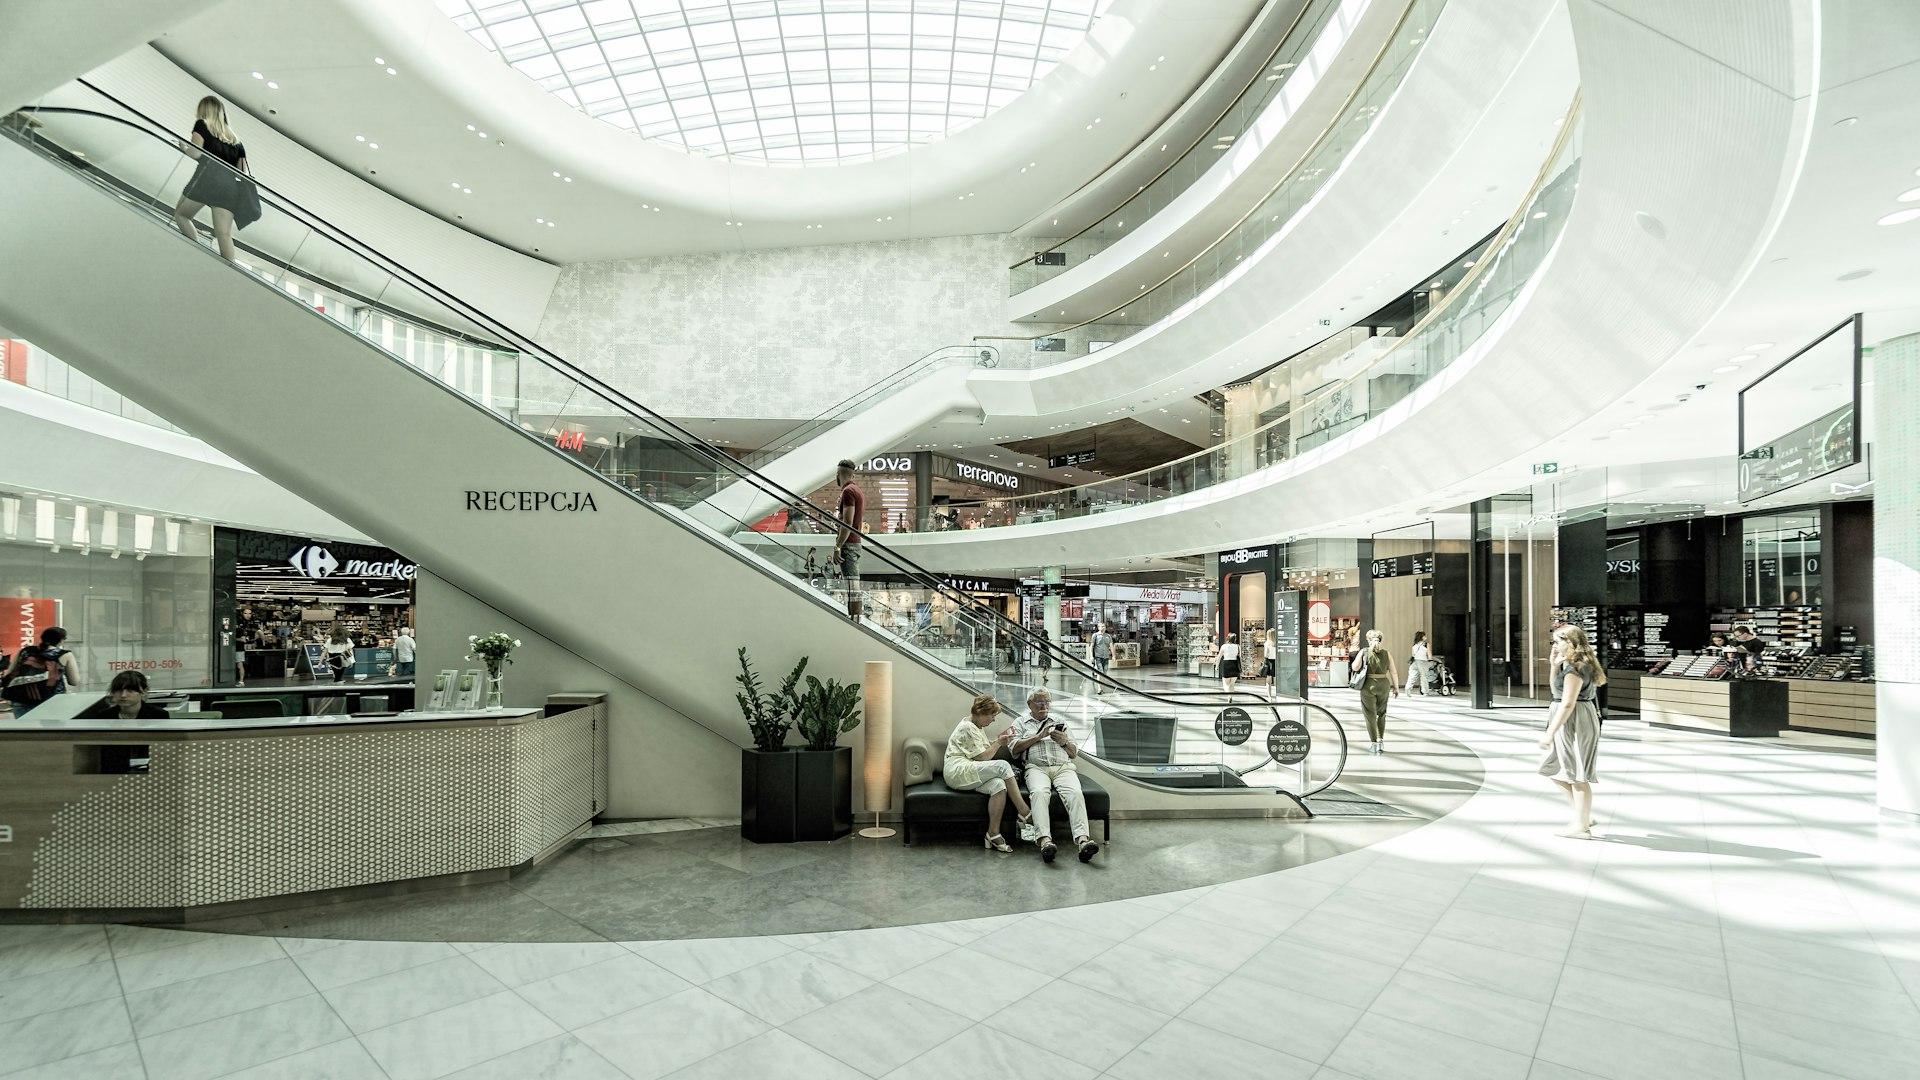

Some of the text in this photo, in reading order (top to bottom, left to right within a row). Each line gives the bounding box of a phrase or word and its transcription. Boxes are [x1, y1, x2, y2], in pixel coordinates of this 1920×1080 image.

[464, 490, 597, 512] RECEPCJA
[1372, 562, 1379, 576] 0
[1311, 616, 1328, 624] SALE
[108, 659, 183, 671] TERAZ DO -50%
